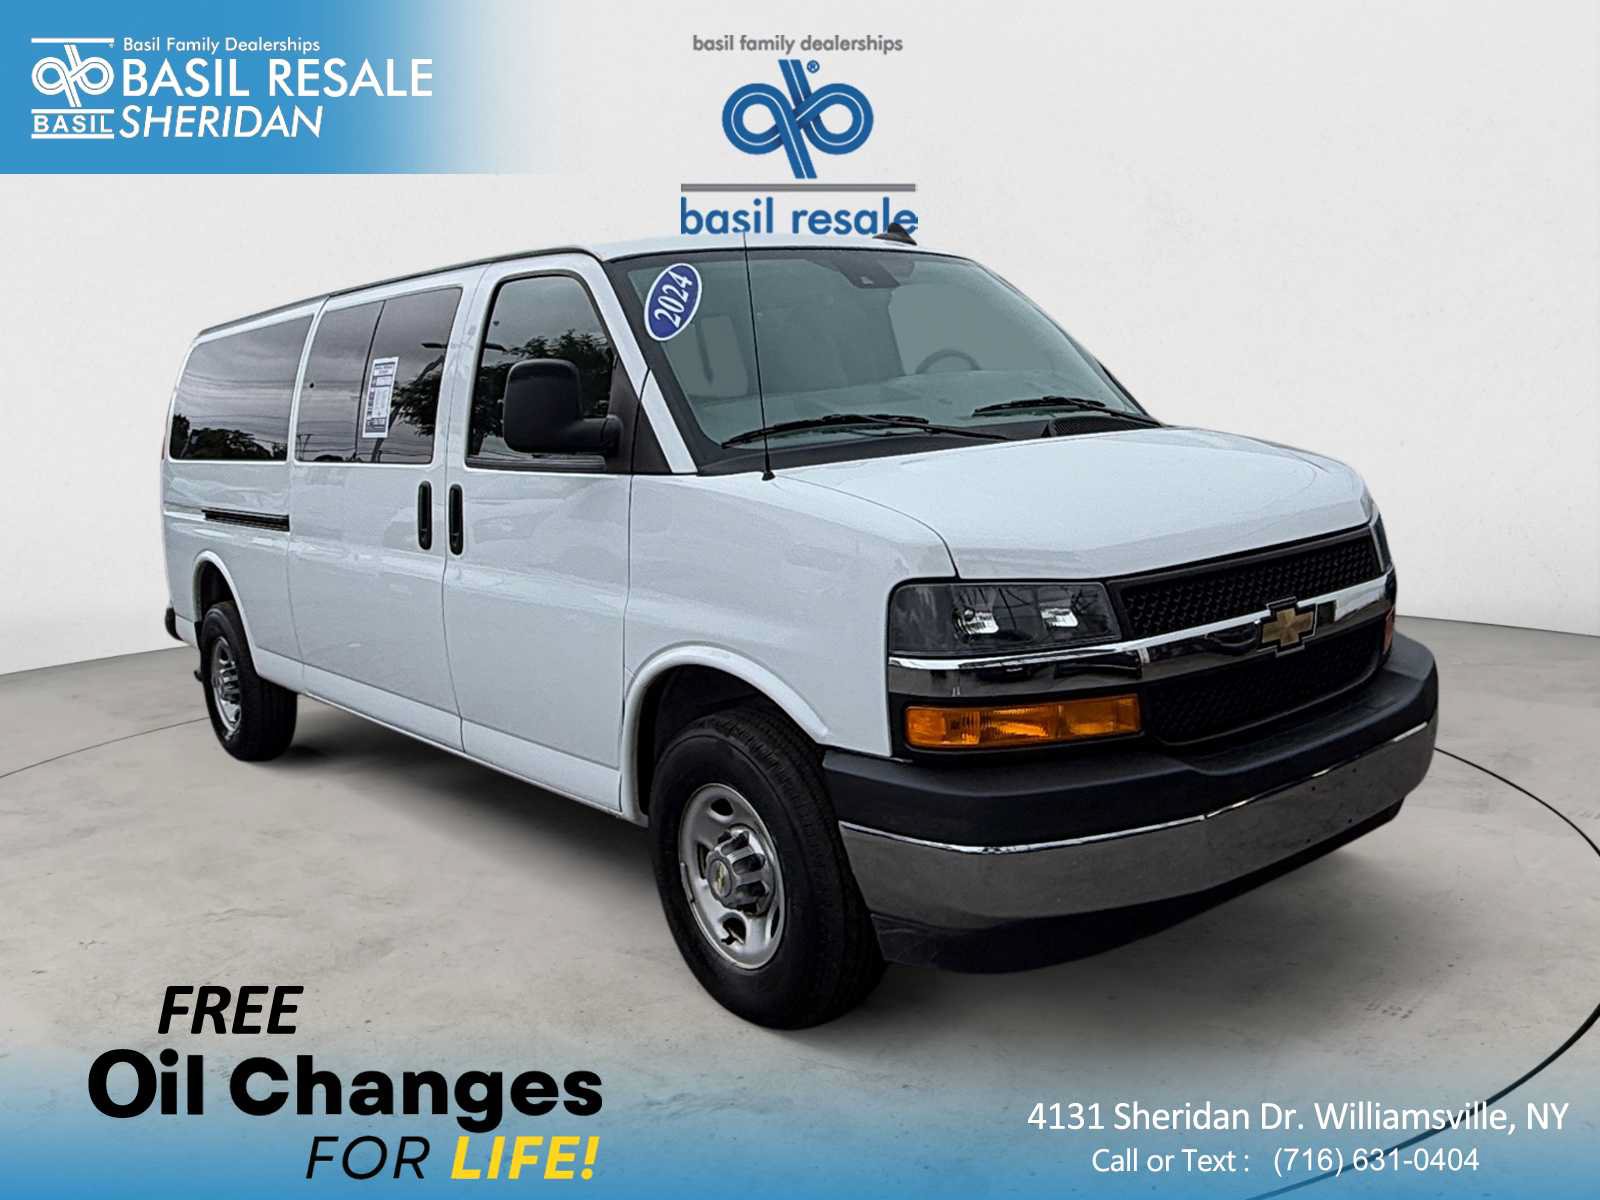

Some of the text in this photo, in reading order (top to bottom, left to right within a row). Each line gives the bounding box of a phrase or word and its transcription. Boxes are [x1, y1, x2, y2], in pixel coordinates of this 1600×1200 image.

[692, 35, 904, 55] basil family dealerships
[681, 197, 919, 235] basil resale
[654, 270, 693, 329] 2024
